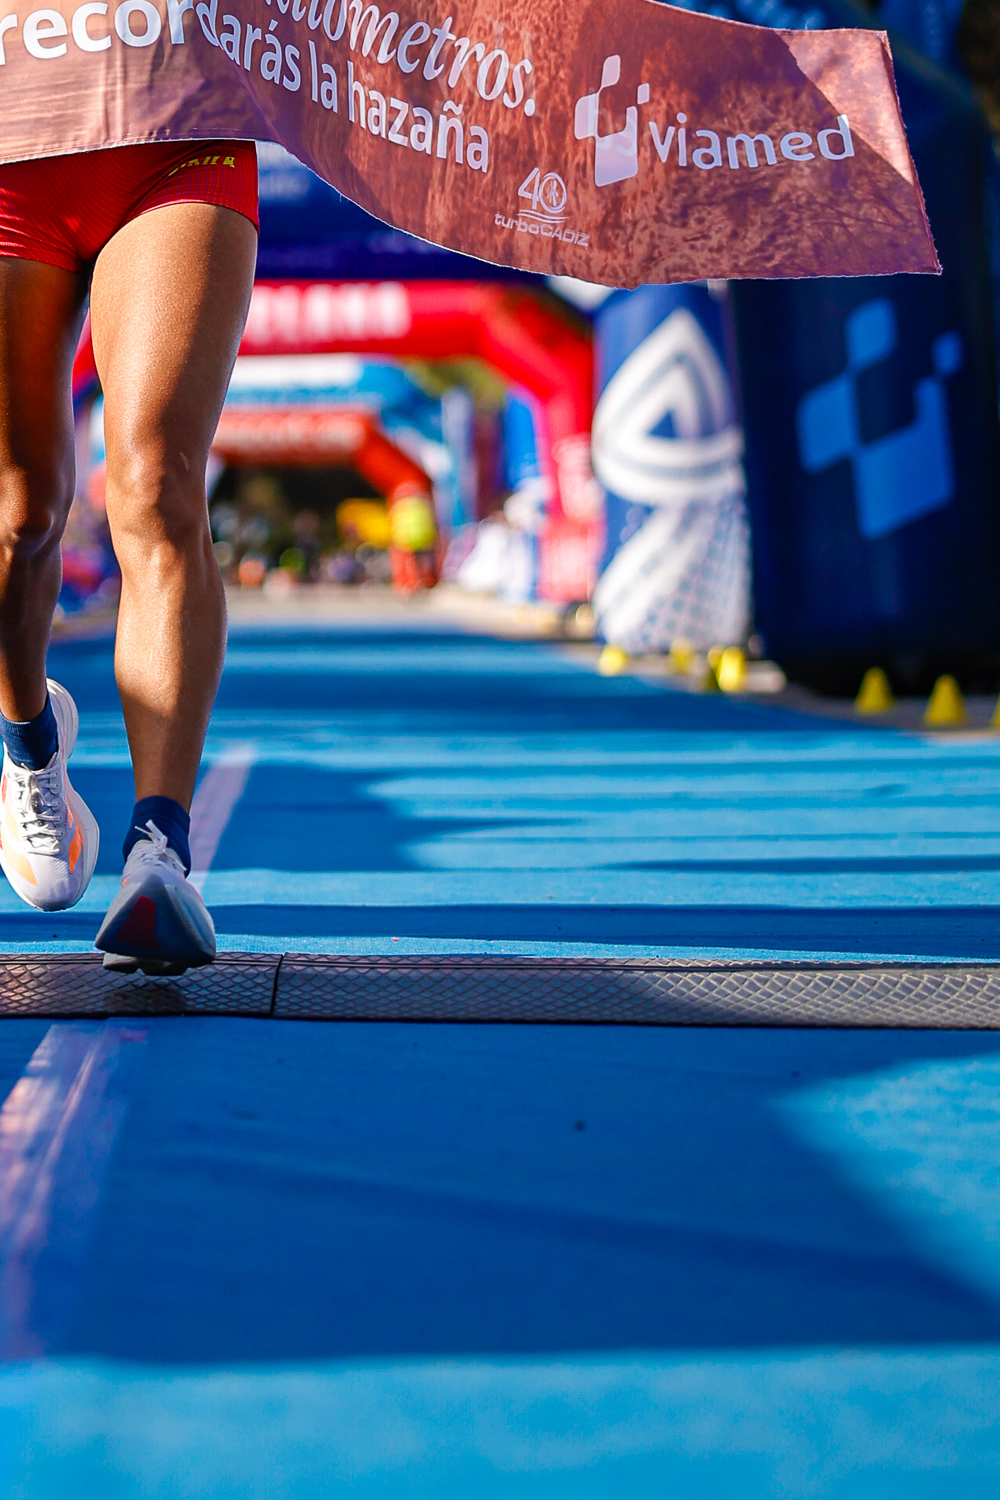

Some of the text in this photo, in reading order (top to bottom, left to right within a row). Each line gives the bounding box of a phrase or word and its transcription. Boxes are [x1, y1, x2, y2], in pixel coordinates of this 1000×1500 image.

[308, 40, 338, 114] la
[347, 60, 490, 173] hazaña
[649, 112, 855, 170] viamed
[518, 166, 567, 214] 40
